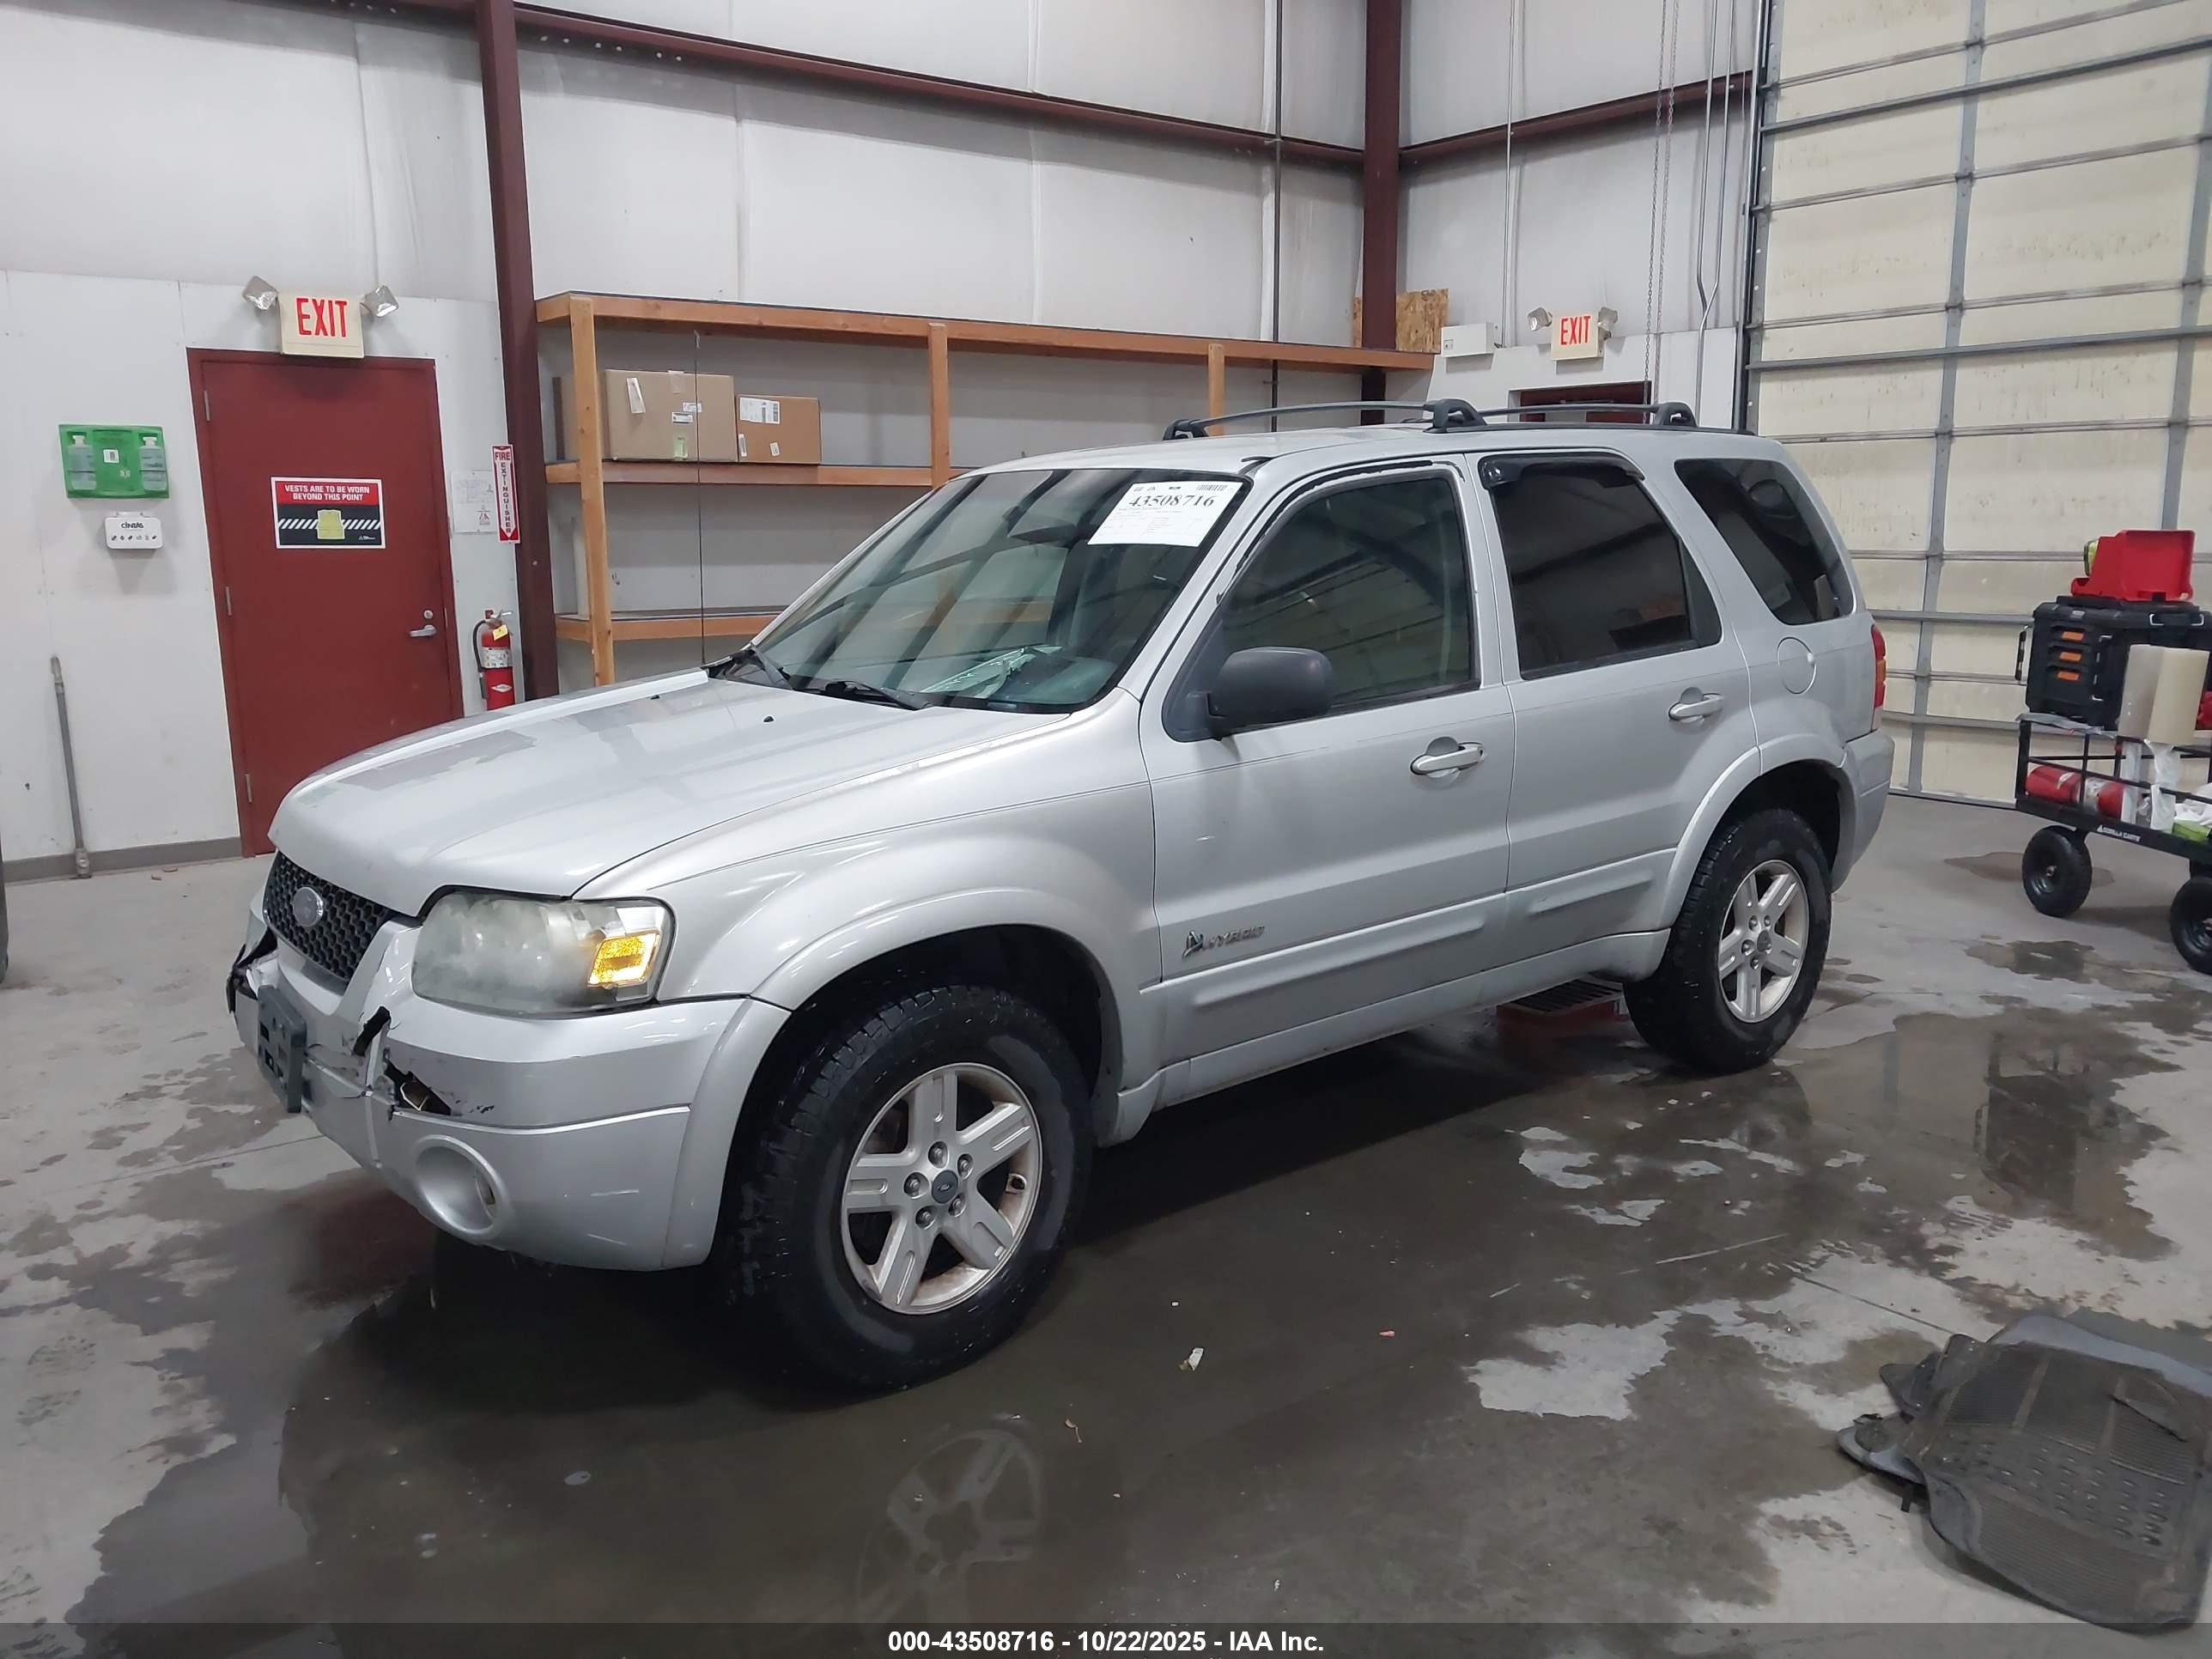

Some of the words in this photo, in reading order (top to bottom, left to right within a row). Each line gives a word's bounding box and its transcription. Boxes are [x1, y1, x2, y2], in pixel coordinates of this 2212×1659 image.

[296, 297, 348, 338] EXIT
[1560, 315, 1591, 345] EXIT
[495, 452, 511, 461] FIRE
[284, 484, 308, 493] VESTS
[310, 485, 325, 494] ARE
[347, 486, 370, 495] WORN
[501, 462, 512, 533] EXTINGUISHER
[1127, 495, 1217, 507] 43508716
